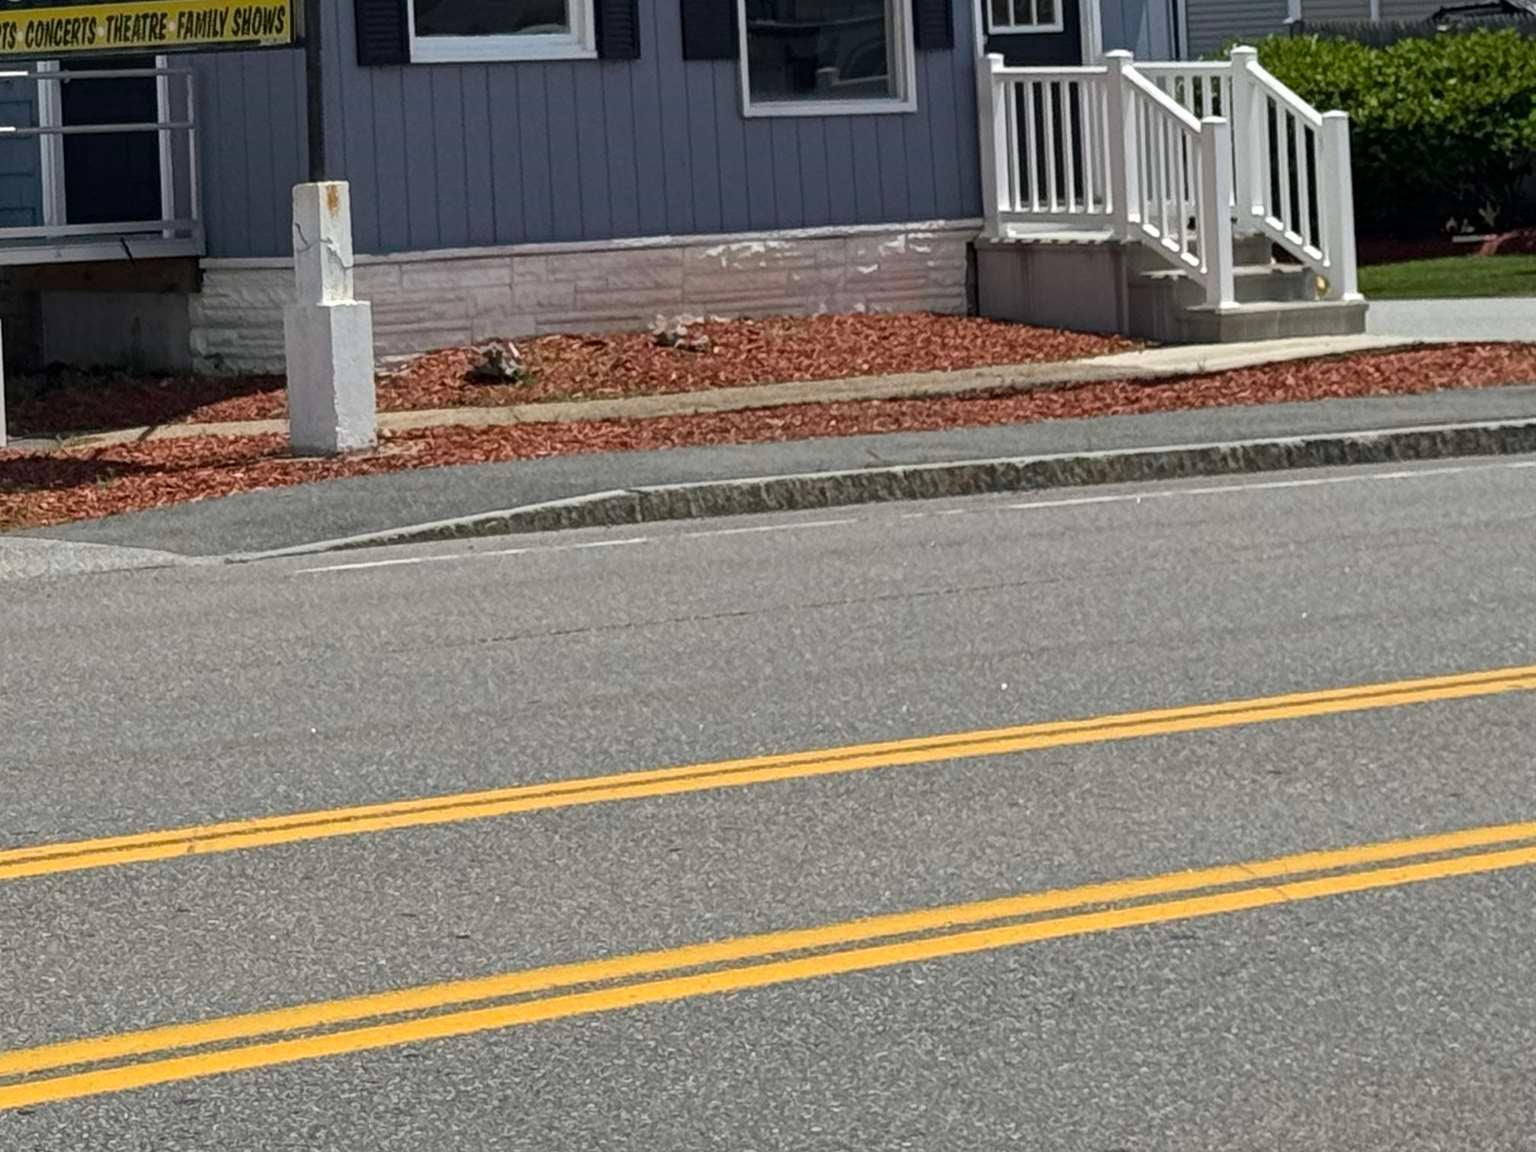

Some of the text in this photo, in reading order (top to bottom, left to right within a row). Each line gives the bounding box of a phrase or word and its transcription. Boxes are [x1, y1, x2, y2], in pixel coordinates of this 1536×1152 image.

[25, 16, 98, 47] CONCERTS
[106, 12, 168, 43] THEATRE
[175, 6, 229, 38] FAMILY
[232, 5, 286, 36] SHOWS
